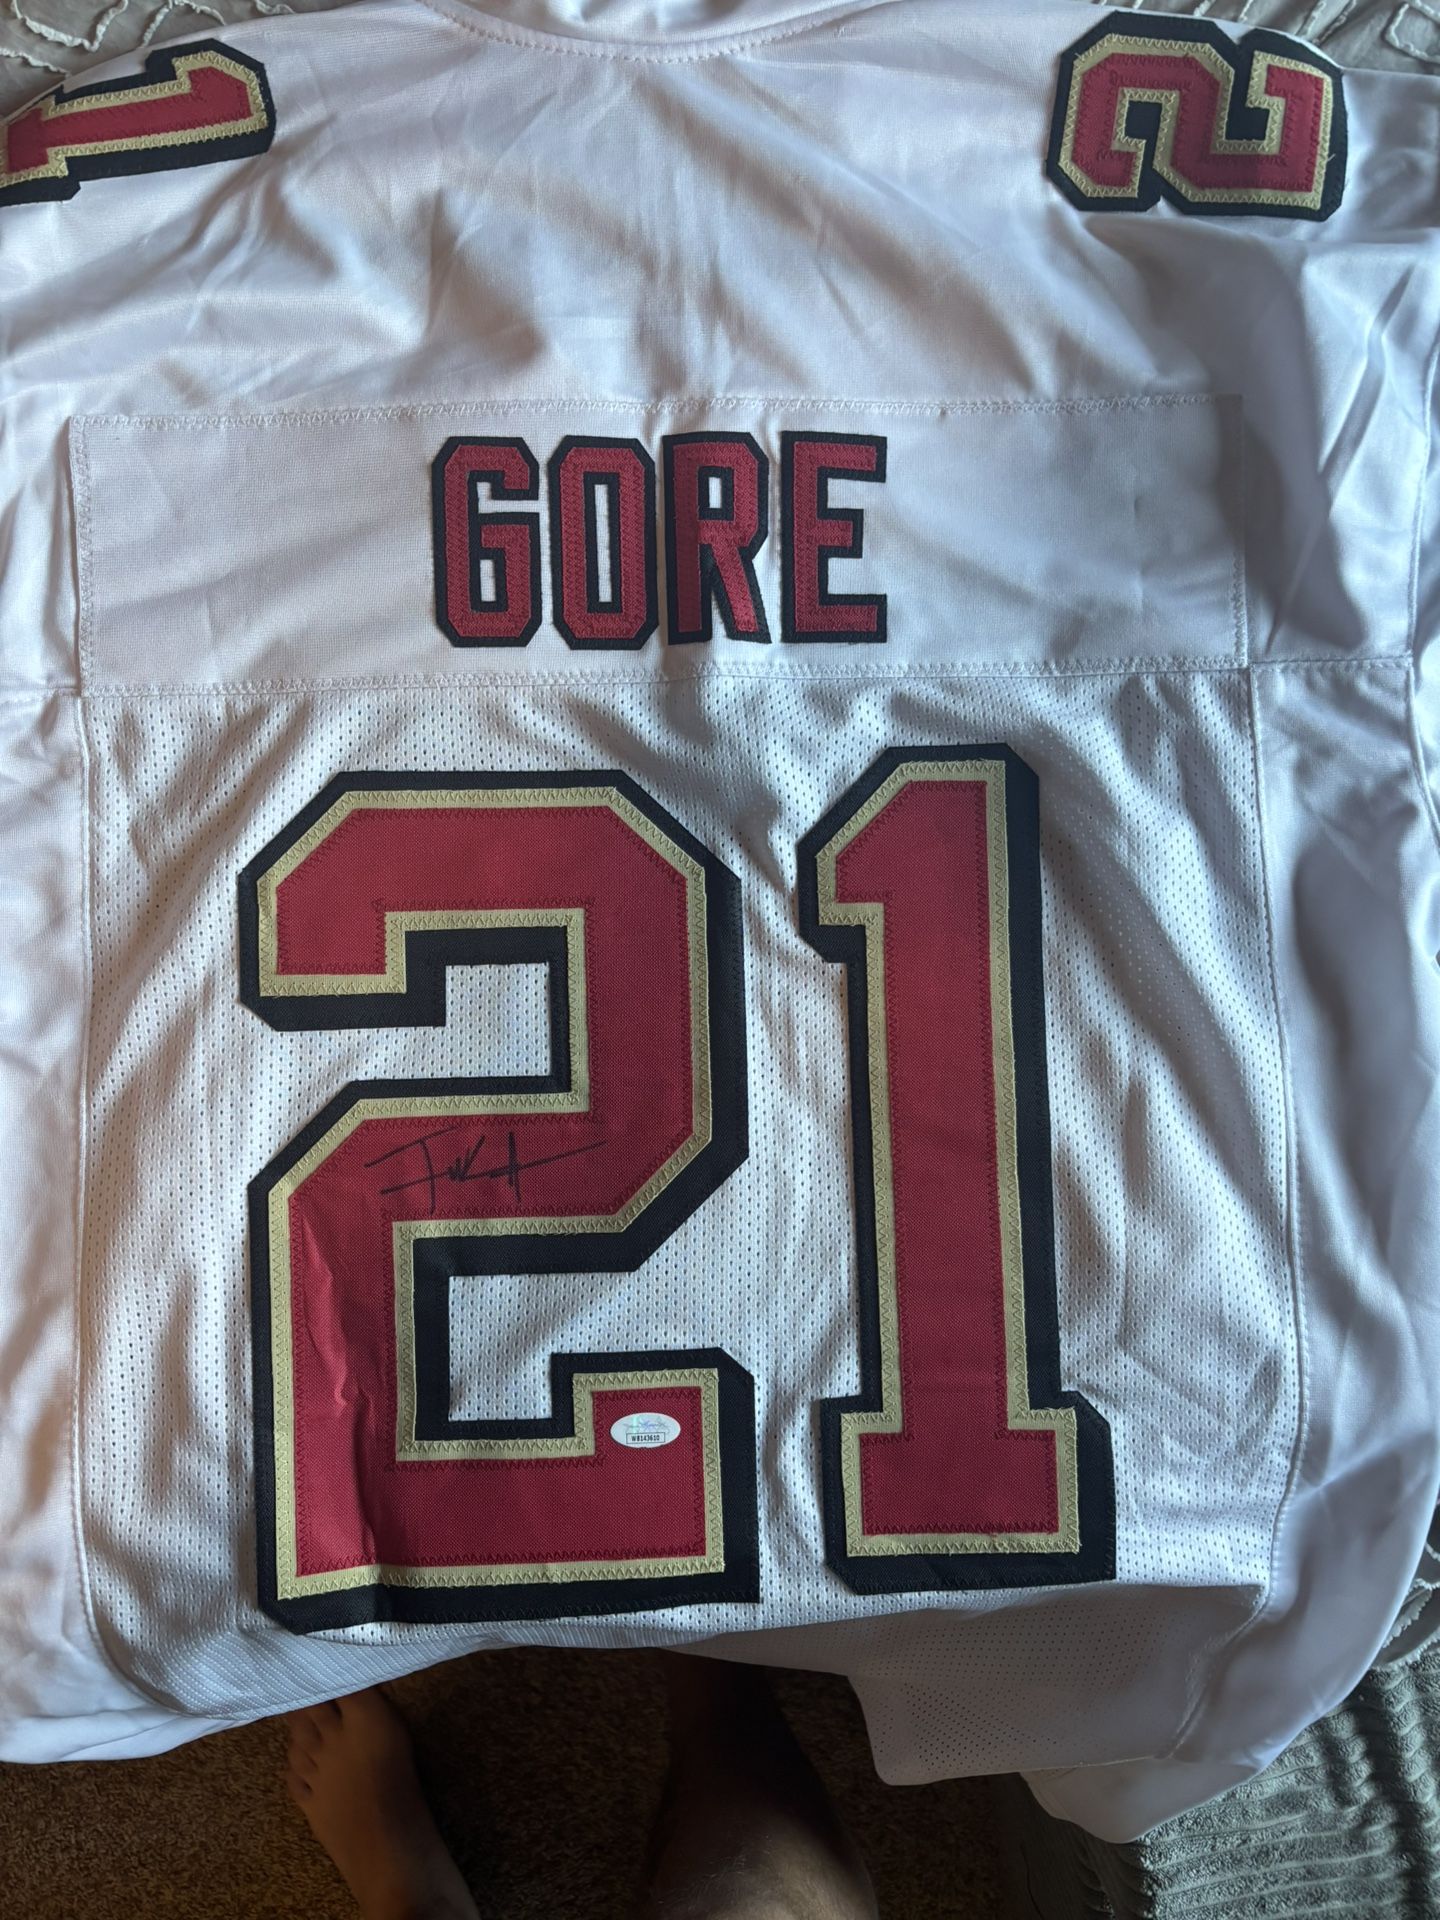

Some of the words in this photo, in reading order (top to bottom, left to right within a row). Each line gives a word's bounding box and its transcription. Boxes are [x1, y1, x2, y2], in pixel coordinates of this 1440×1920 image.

[0, 38, 277, 207] 1
[1046, 10, 1348, 222] 2
[432, 431, 888, 650] GORE
[238, 743, 1116, 1635] 21
